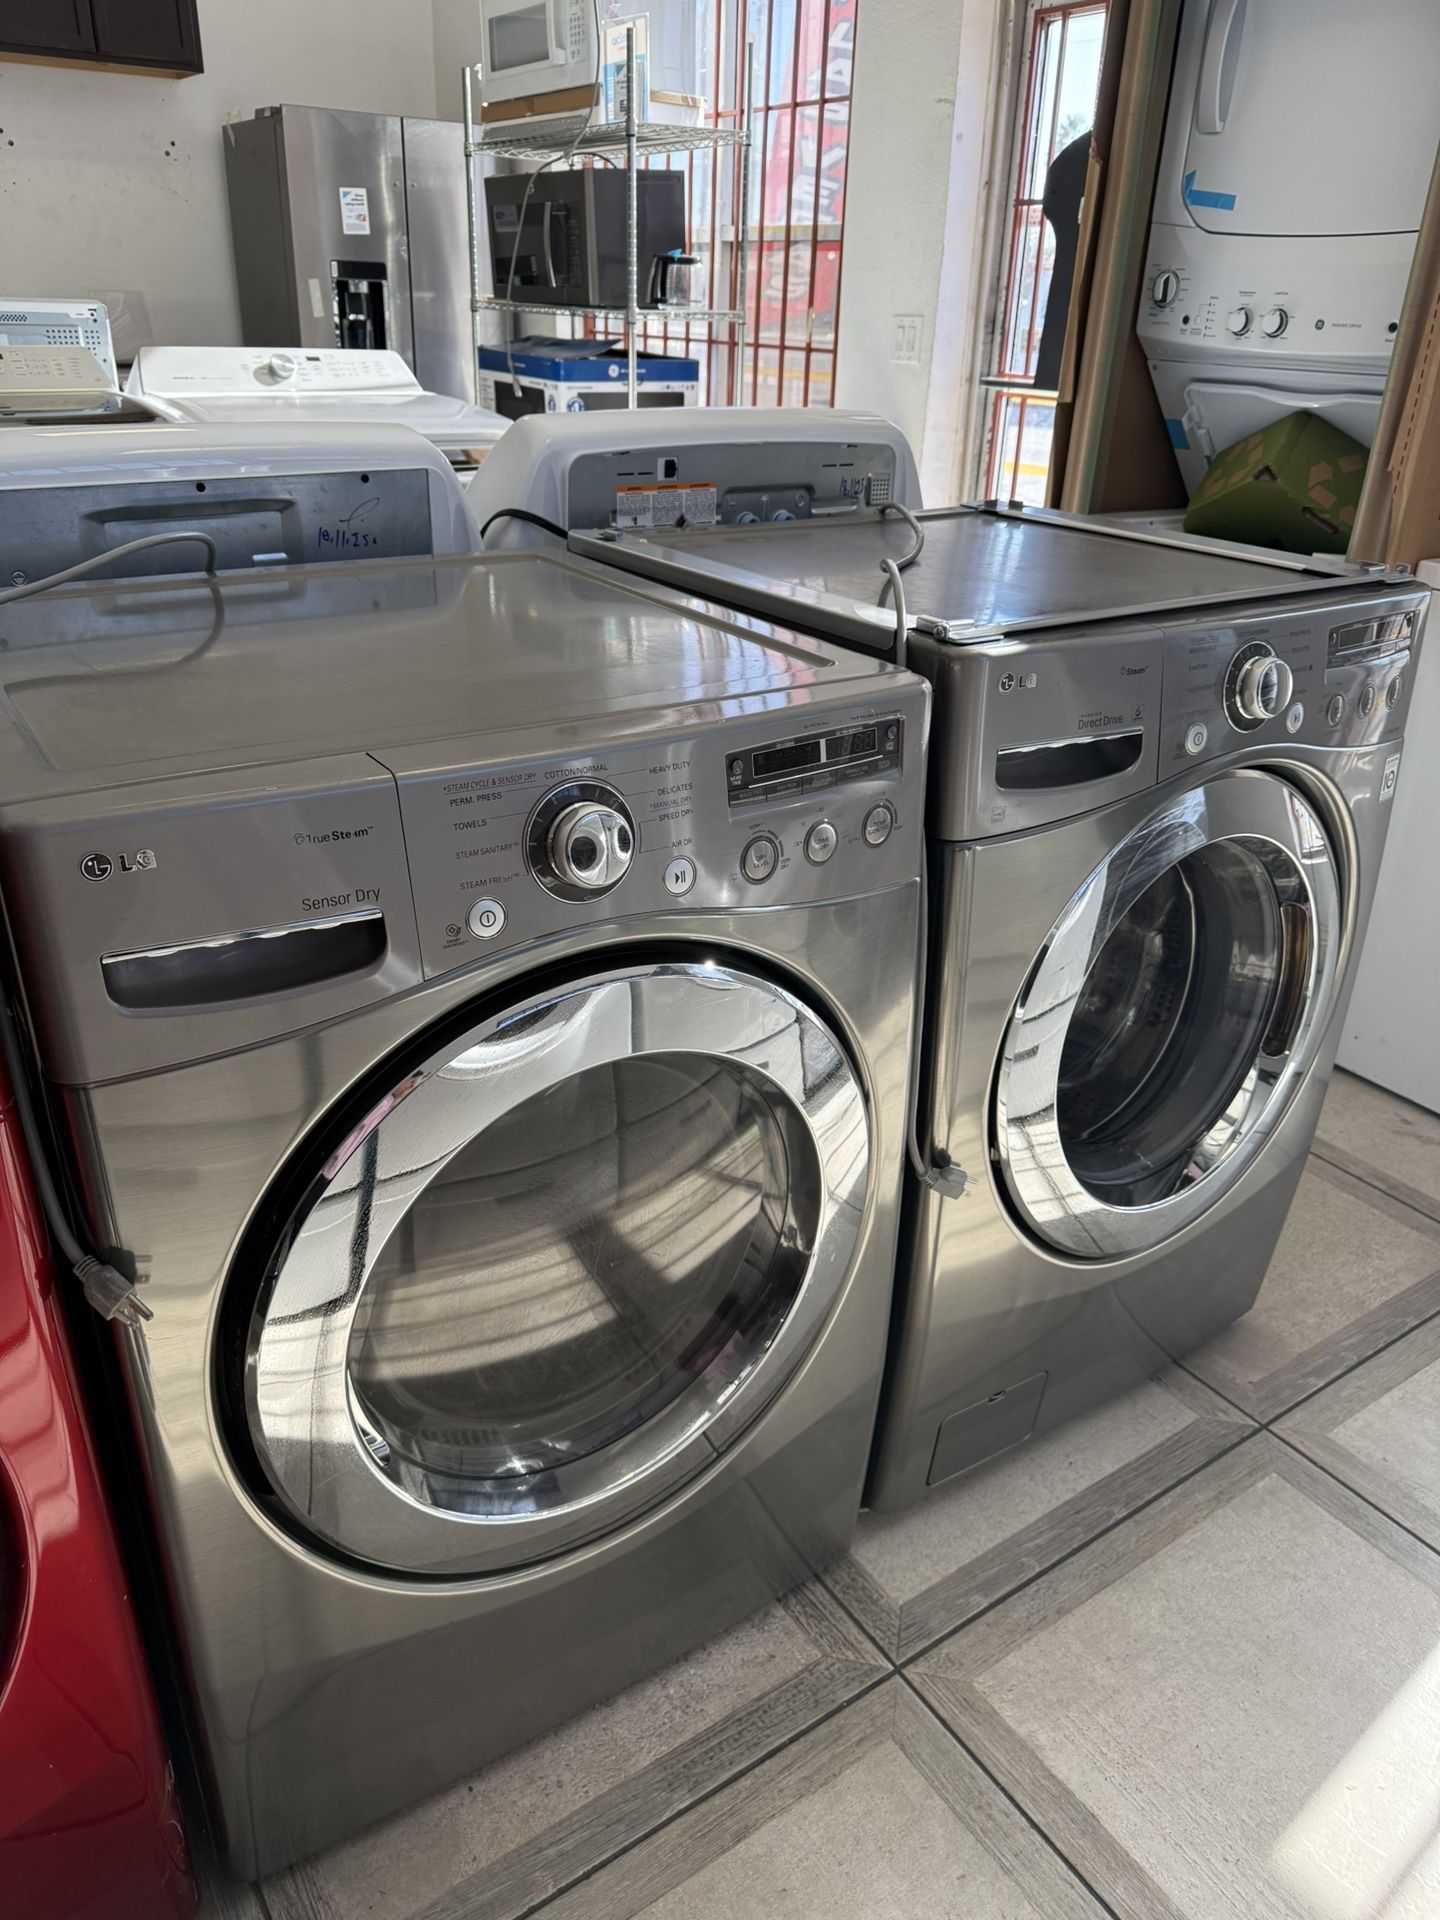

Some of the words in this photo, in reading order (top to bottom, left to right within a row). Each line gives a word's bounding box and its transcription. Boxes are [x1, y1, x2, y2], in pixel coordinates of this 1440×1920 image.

[1018, 672, 1037, 689] LG
[1078, 717, 1102, 730] Direct
[1103, 714, 1124, 727] Drive
[649, 765, 671, 775] HEAVY
[672, 761, 692, 772] DUTY
[470, 779, 490, 790] CYCLE
[491, 777, 497, 786] &
[497, 774, 523, 786] SENSOR
[524, 771, 537, 781] DRY
[657, 782, 693, 796] DELICATES
[477, 791, 503, 803] PRESS
[658, 811, 680, 822] SPEED
[453, 818, 488, 832] TOWELS
[456, 847, 480, 860] STEAM
[118, 848, 157, 874] LG
[460, 878, 488, 892] STEAM
[302, 892, 352, 912] Sensor
[355, 887, 381, 903] Dry
